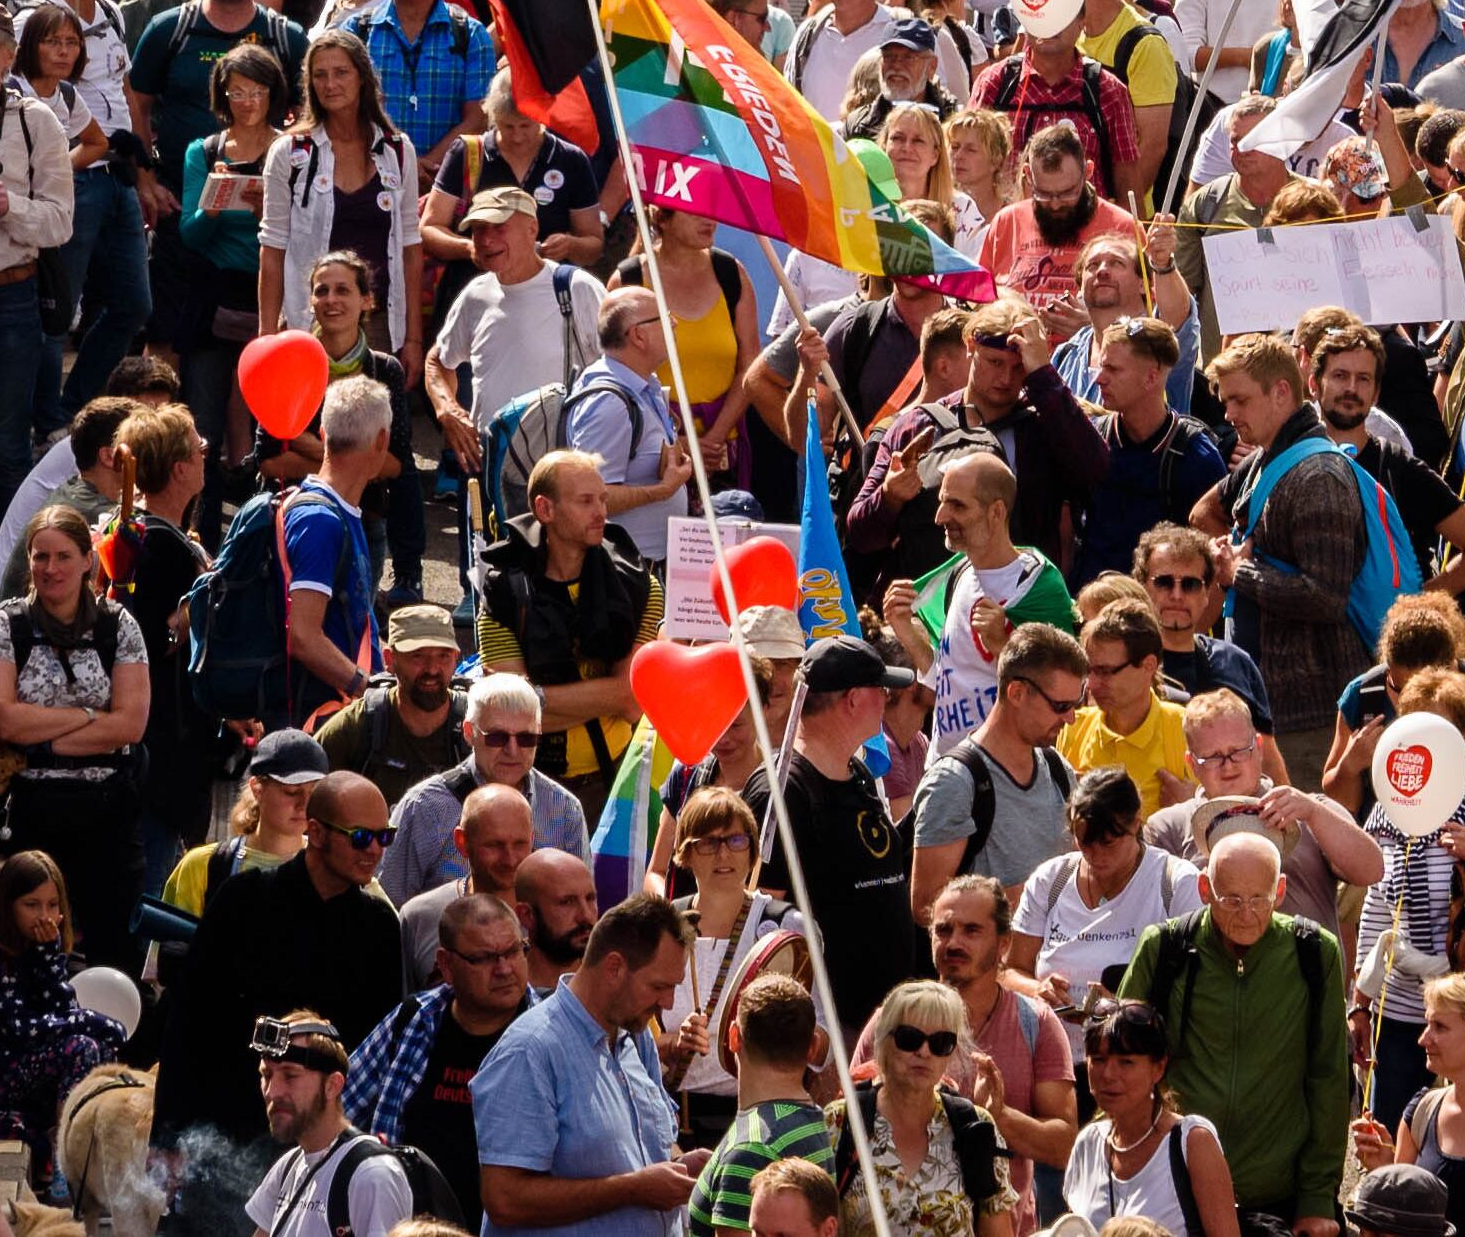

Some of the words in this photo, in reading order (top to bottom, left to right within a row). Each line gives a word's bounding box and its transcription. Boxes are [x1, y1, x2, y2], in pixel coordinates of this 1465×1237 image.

[1394, 752, 1425, 765] FRIEDEN
[1391, 762, 1423, 775] FREIHEIT
[1391, 773, 1423, 791] LIEBE
